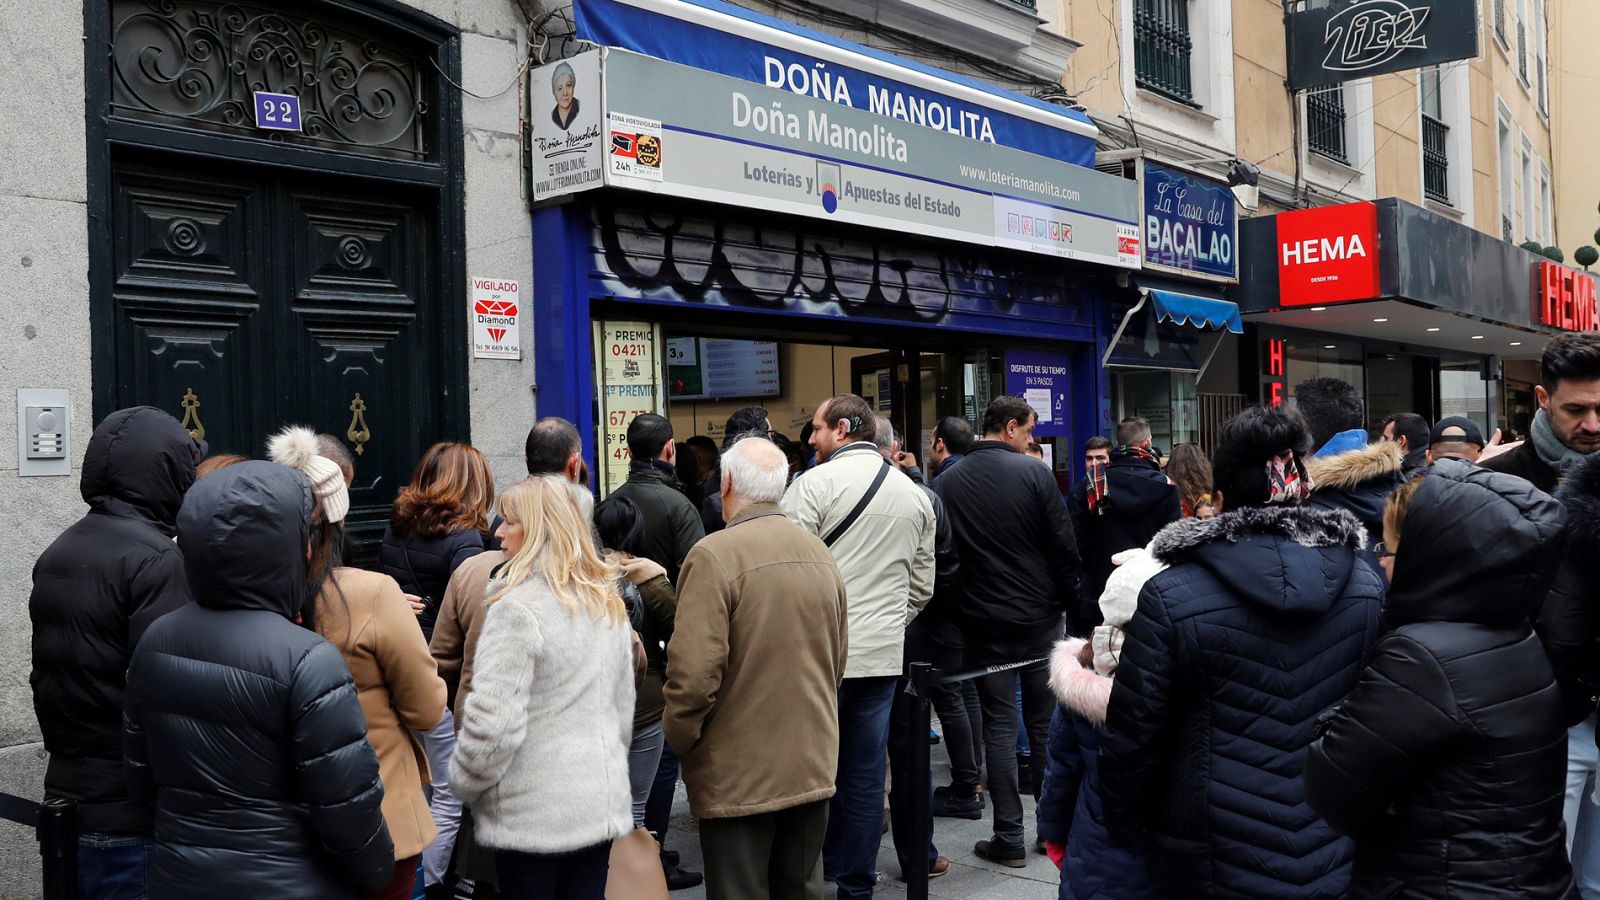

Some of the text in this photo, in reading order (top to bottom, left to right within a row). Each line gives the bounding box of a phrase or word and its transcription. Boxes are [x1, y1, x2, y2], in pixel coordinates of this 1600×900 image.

[764, 55, 998, 144] DOÑA MANOLITA
[263, 100, 292, 123] 22
[611, 114, 624, 122] ZONA
[732, 91, 908, 163] Doña Manolita
[554, 157, 586, 174] TIENDA ONLINE
[616, 161, 631, 172] 24h
[743, 161, 961, 217] Loterías y Apuestas del Estado
[960, 164, 1080, 202] www.loteriamanolita.com
[1154, 182, 1225, 227] La Casa del
[1147, 215, 1231, 264] BACALAO
[1282, 234, 1366, 266] HEMA
[474, 280, 518, 293] VIGILADO
[1541, 260, 1600, 331] HEMA
[612, 344, 646, 356] 04211
[670, 348, 684, 359] 3,9
[1011, 364, 1066, 375] DISFRUTE DE SU TIEMPO
[619, 385, 658, 397] PREMIO
[1026, 377, 1053, 386] EN 3 PASOS
